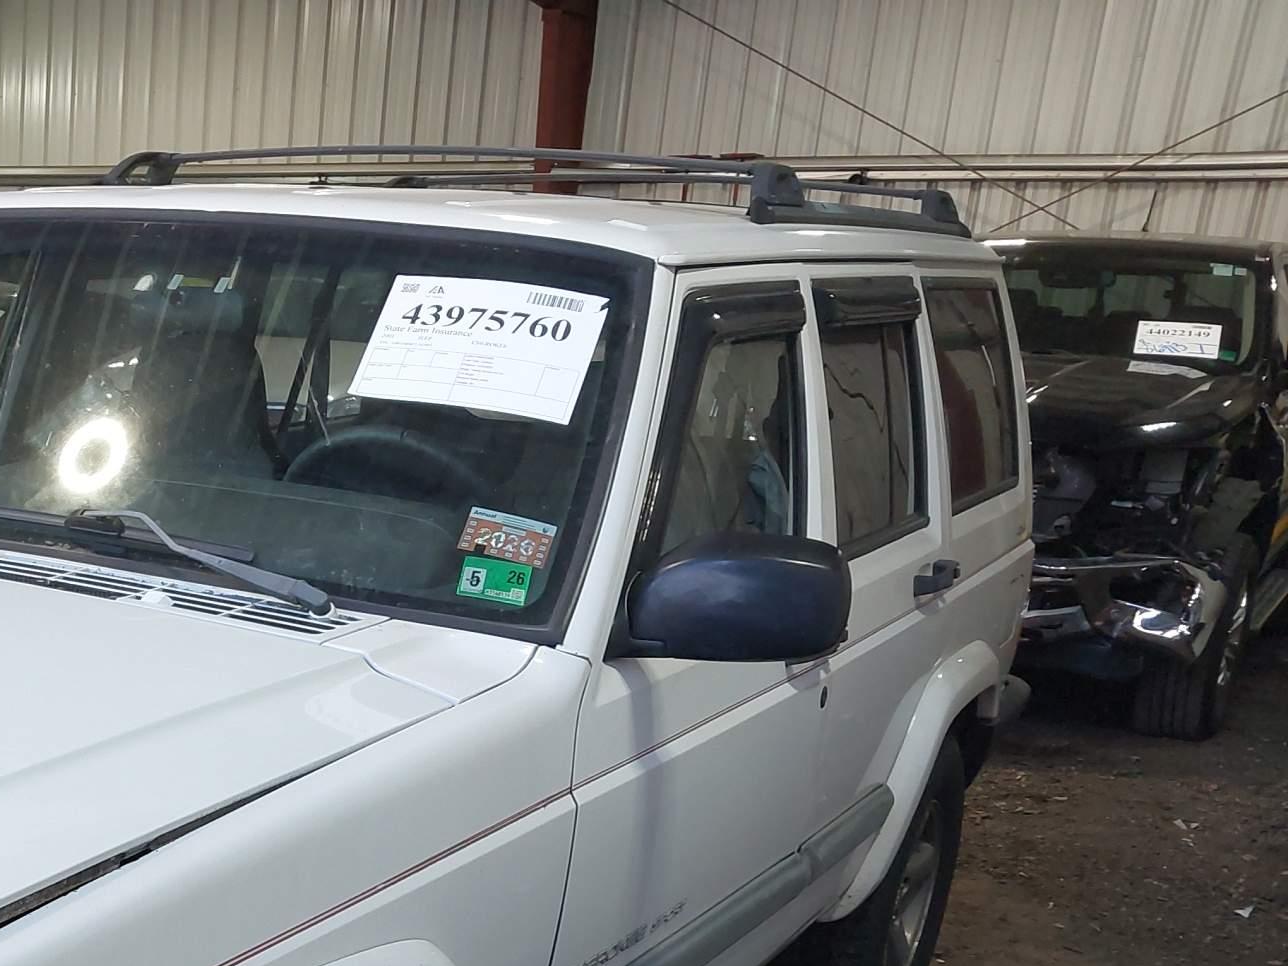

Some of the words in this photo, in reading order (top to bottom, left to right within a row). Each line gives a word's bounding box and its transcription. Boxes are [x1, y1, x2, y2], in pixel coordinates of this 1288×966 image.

[401, 302, 572, 342] 43975760
[383, 325, 406, 333] State
[407, 325, 429, 334] Farm
[431, 327, 473, 338] Insurance
[1145, 328, 1211, 338] 44022149
[507, 570, 526, 586] 26
